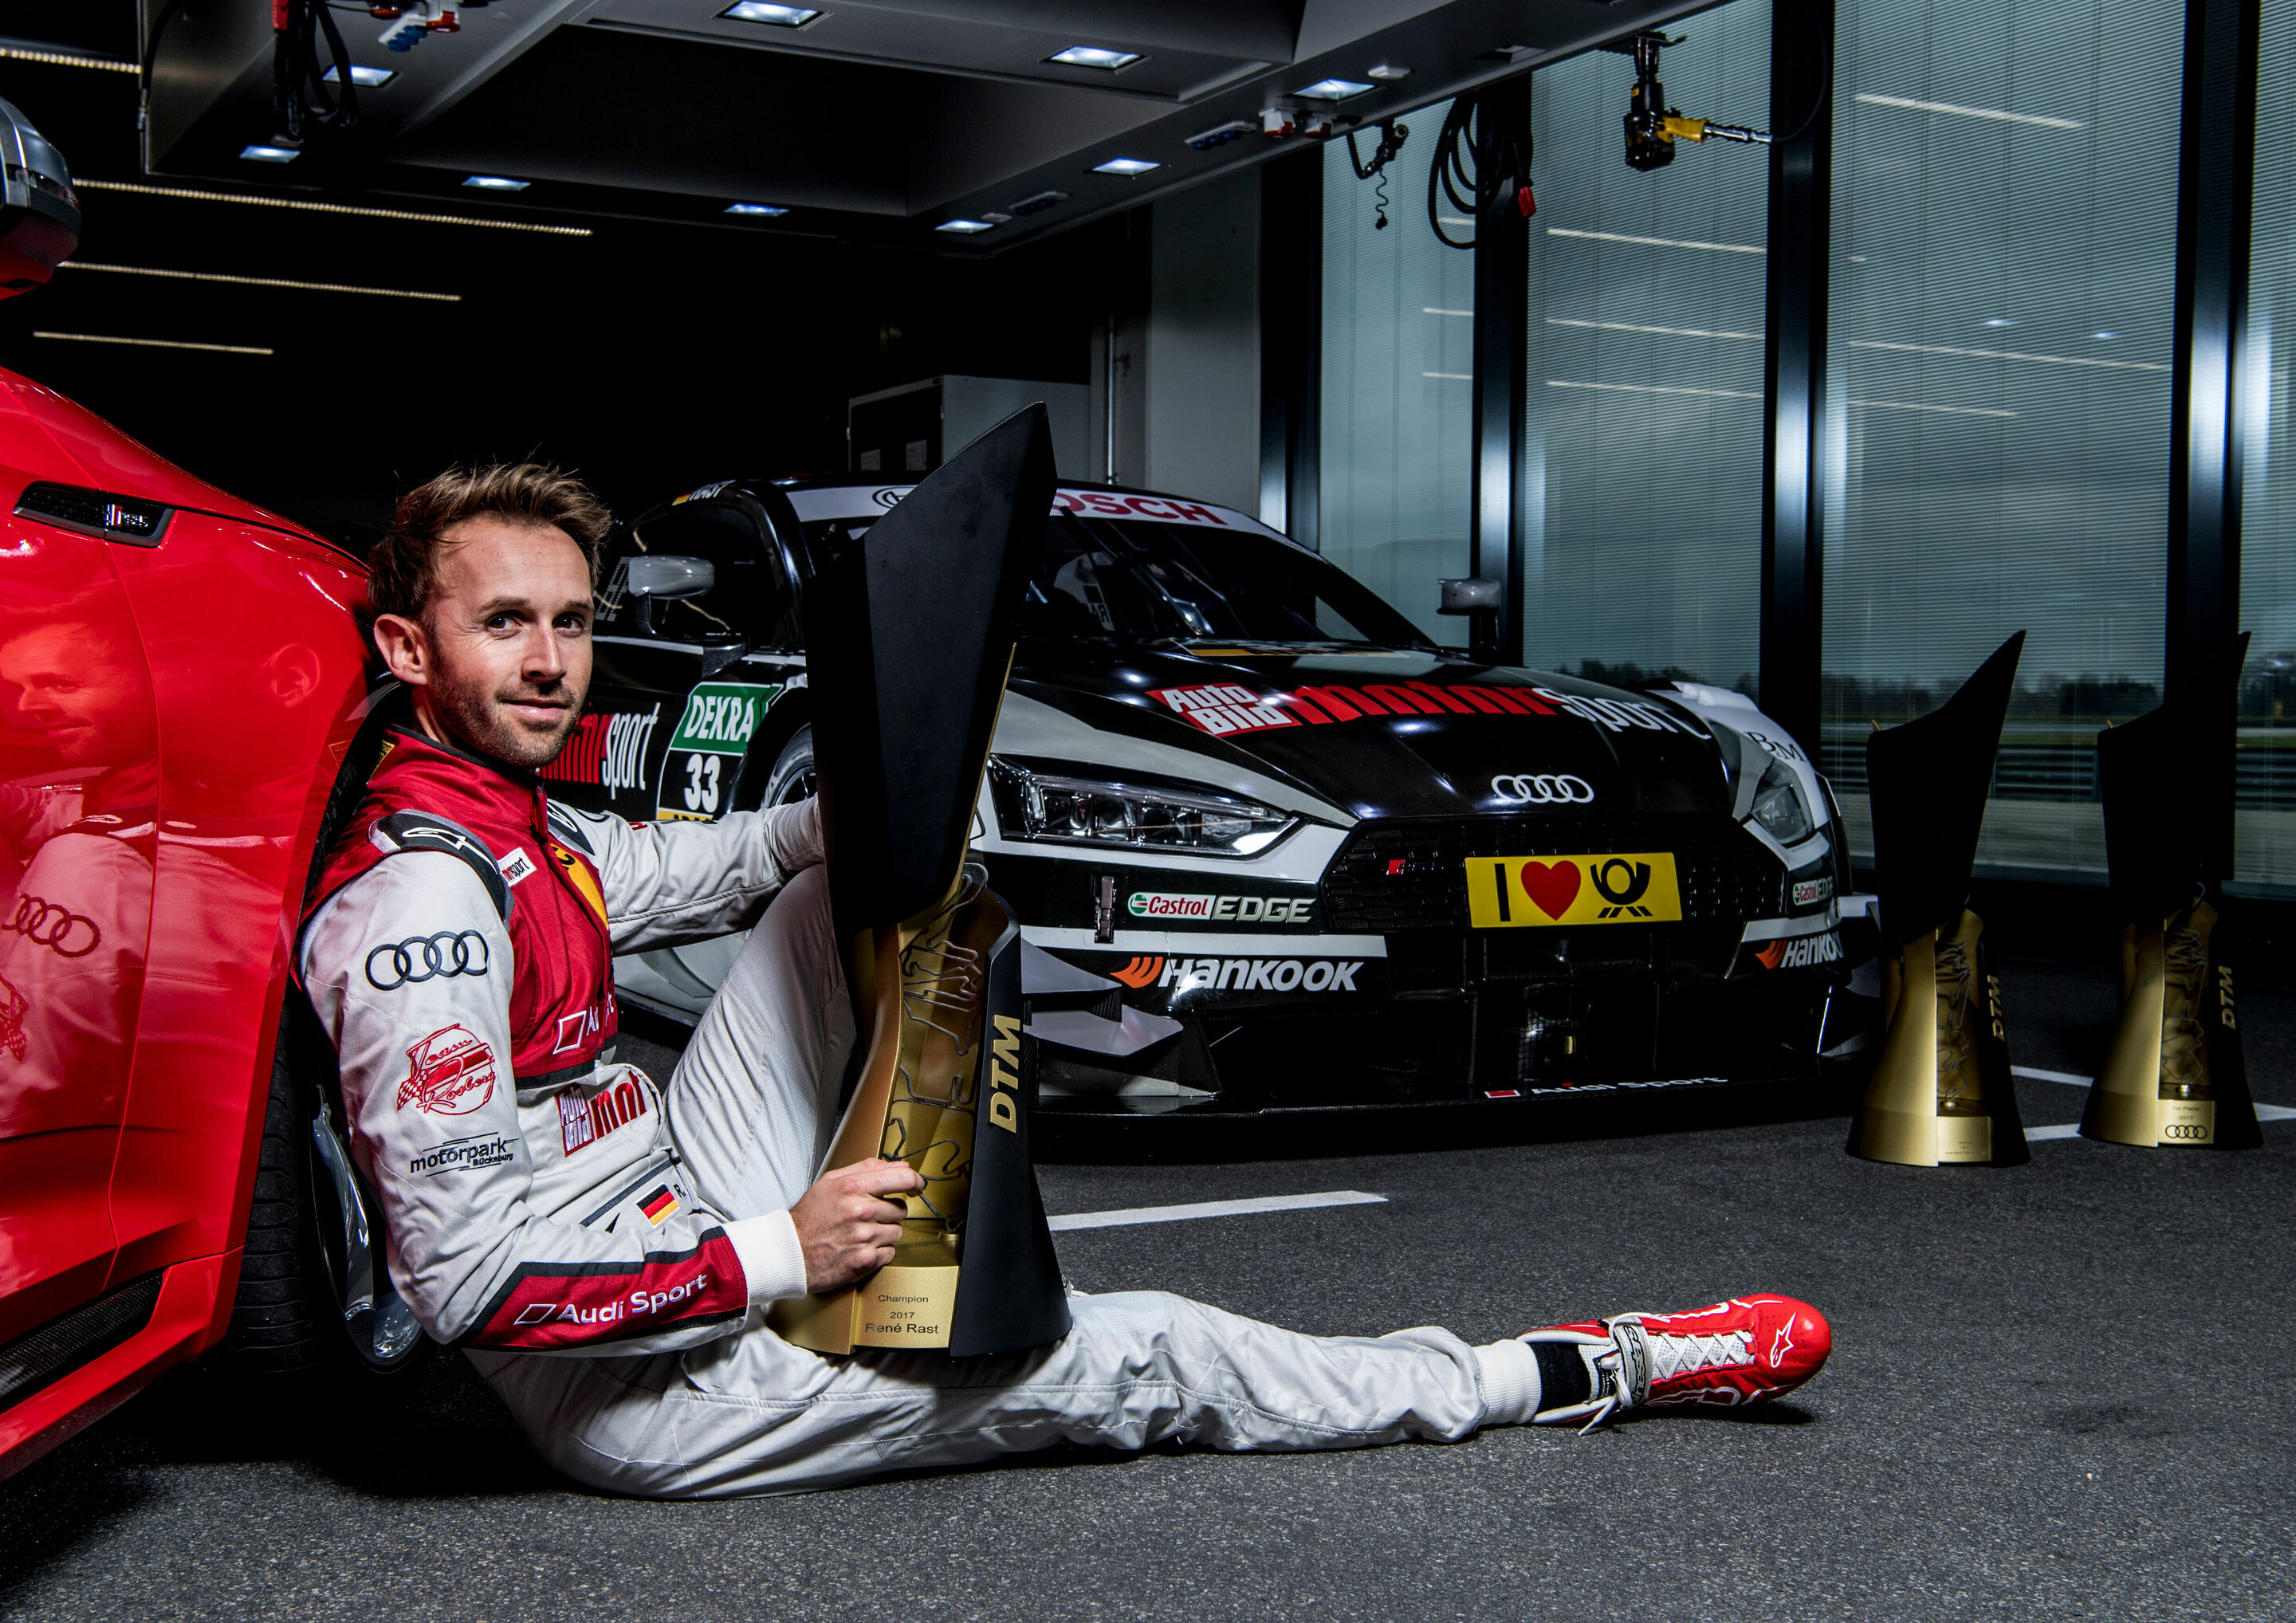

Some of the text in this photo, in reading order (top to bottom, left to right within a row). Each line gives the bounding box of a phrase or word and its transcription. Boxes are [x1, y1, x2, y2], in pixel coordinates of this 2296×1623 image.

[1055, 491, 1229, 526] OSCH
[1162, 685, 1260, 713] Auto
[683, 695, 755, 742] DEKRA
[1187, 701, 1293, 735] Bild
[684, 753, 721, 814] 33
[1148, 894, 1316, 923] Castrol EDGE
[2217, 965, 2237, 1032] DTM
[405, 1023, 473, 1082] Team
[989, 1014, 1021, 1134] DTM
[1618, 1077, 1728, 1088] Sport
[410, 1137, 507, 1173] motorpark
[556, 1274, 708, 1324] Audi Sport
[878, 1294, 929, 1304] Champion
[865, 1322, 939, 1334] René Rast
